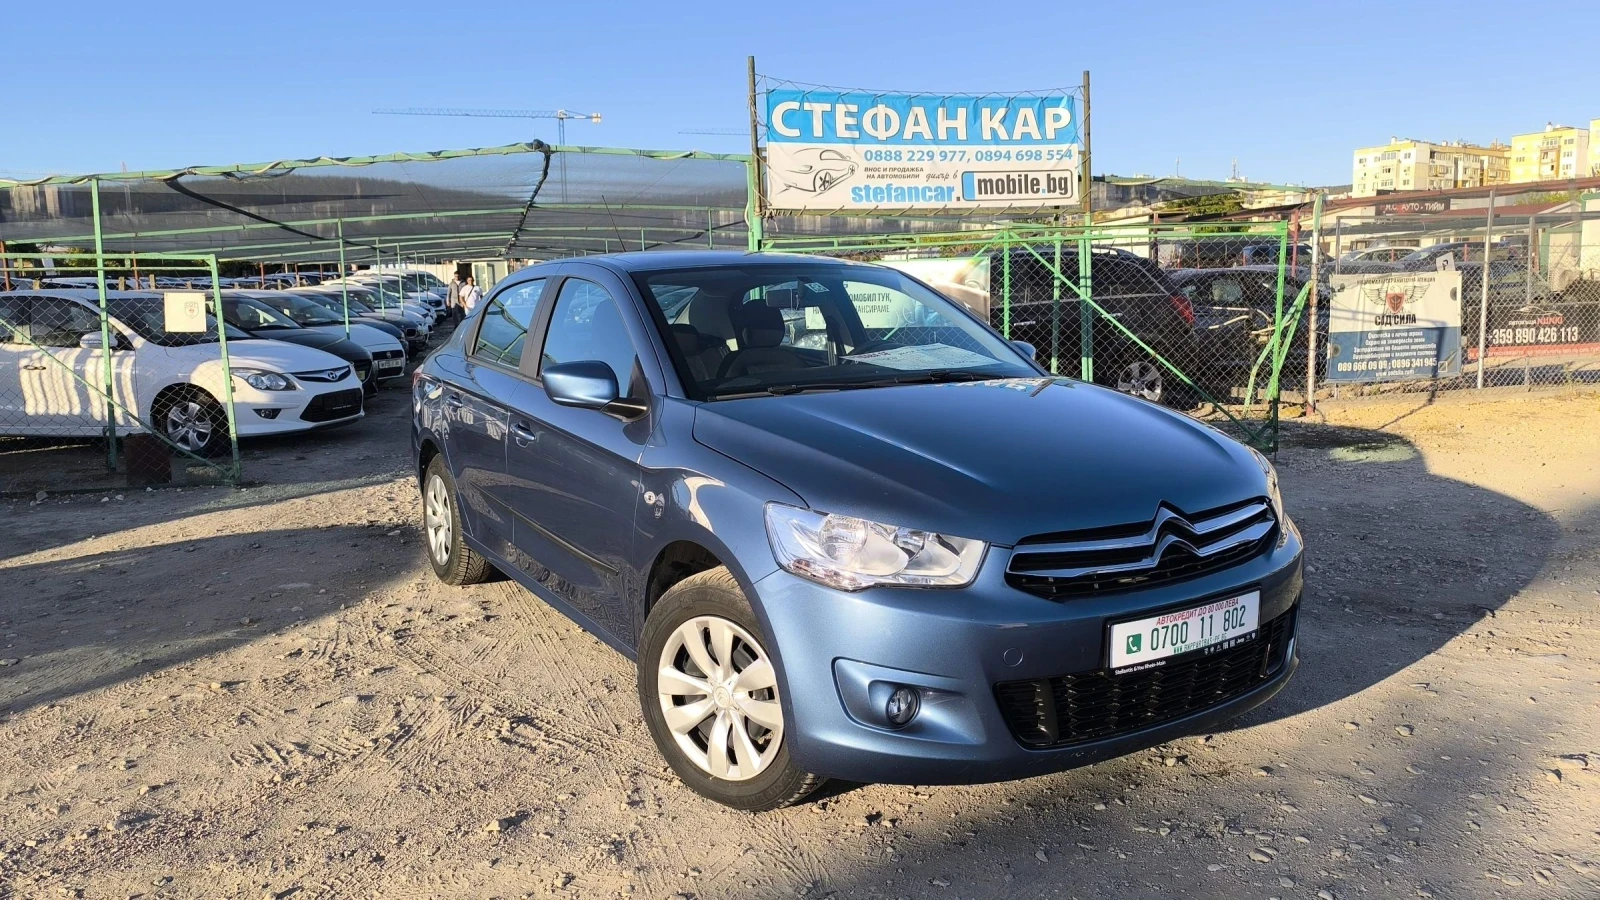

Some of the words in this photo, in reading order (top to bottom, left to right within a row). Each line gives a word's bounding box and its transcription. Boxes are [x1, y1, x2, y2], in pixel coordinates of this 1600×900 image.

[770, 101, 967, 141] СТЕФАН
[981, 106, 1072, 141] КАР
[864, 149, 903, 162] 0888
[907, 150, 935, 162] 229
[939, 149, 971, 164] 977,
[975, 149, 1015, 162] 0894
[1018, 149, 1043, 162] 698
[1046, 149, 1073, 161] 554
[977, 172, 1069, 196] mobile.bg
[1393, 313, 1417, 325] СИЛА
[1515, 327, 1536, 343] 890
[1537, 326, 1557, 343] 426
[1560, 326, 1579, 342] 113
[1337, 362, 1352, 372] 089
[1353, 361, 1367, 371] 666
[1368, 360, 1377, 370] 09
[1378, 360, 1388, 370] 09
[1391, 358, 1411, 369] 0896
[1411, 358, 1423, 367] 341
[1424, 357, 1437, 366] 945
[1156, 608, 1197, 626] АВТОКРЕДИТ
[1197, 606, 1207, 617] ДО
[1214, 603, 1224, 613] 000
[1224, 598, 1239, 610] ЛЕВА
[1150, 621, 1189, 651] 0700
[1200, 614, 1214, 639] 11
[1223, 605, 1246, 632] 802
